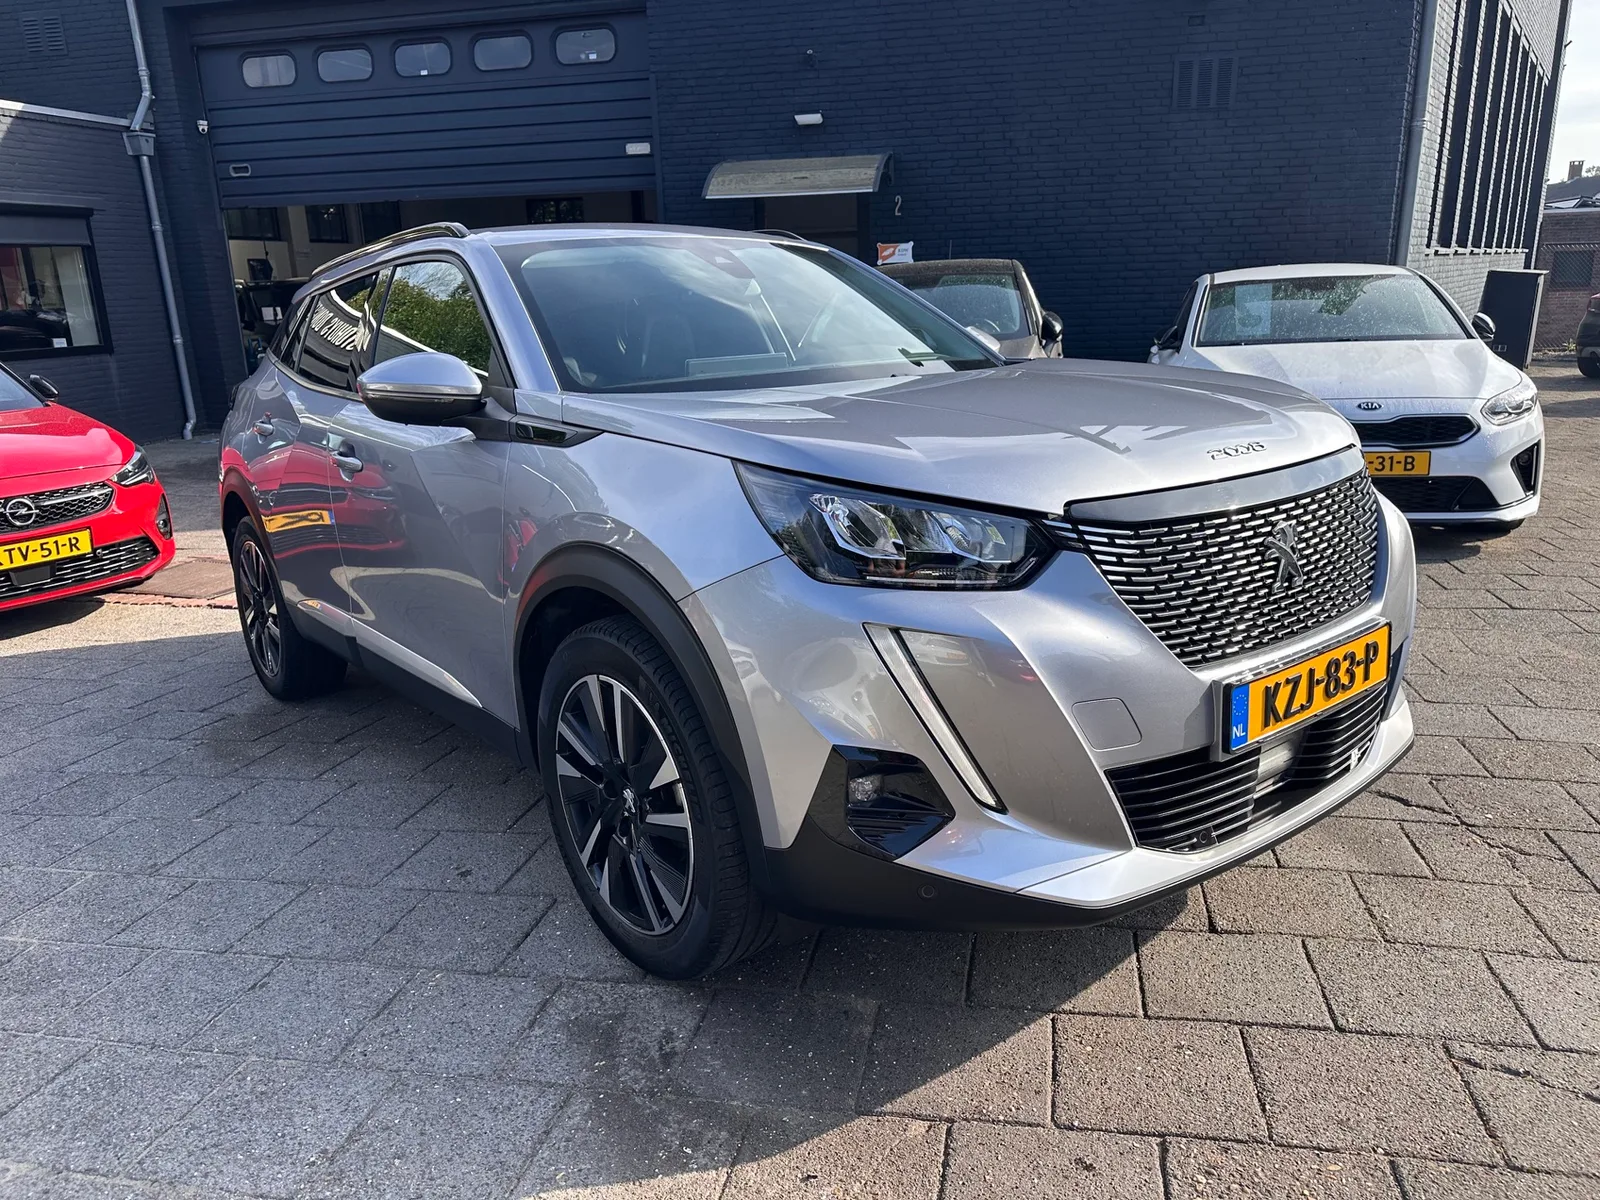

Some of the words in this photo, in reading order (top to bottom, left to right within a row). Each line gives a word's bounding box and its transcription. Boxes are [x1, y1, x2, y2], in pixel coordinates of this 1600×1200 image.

[895, 195, 902, 216] 2
[1206, 442, 1267, 460] 2008
[0, 537, 81, 565] TV-51-R
[1262, 640, 1379, 729] KZJ-83-P
[1232, 723, 1246, 739] NL
